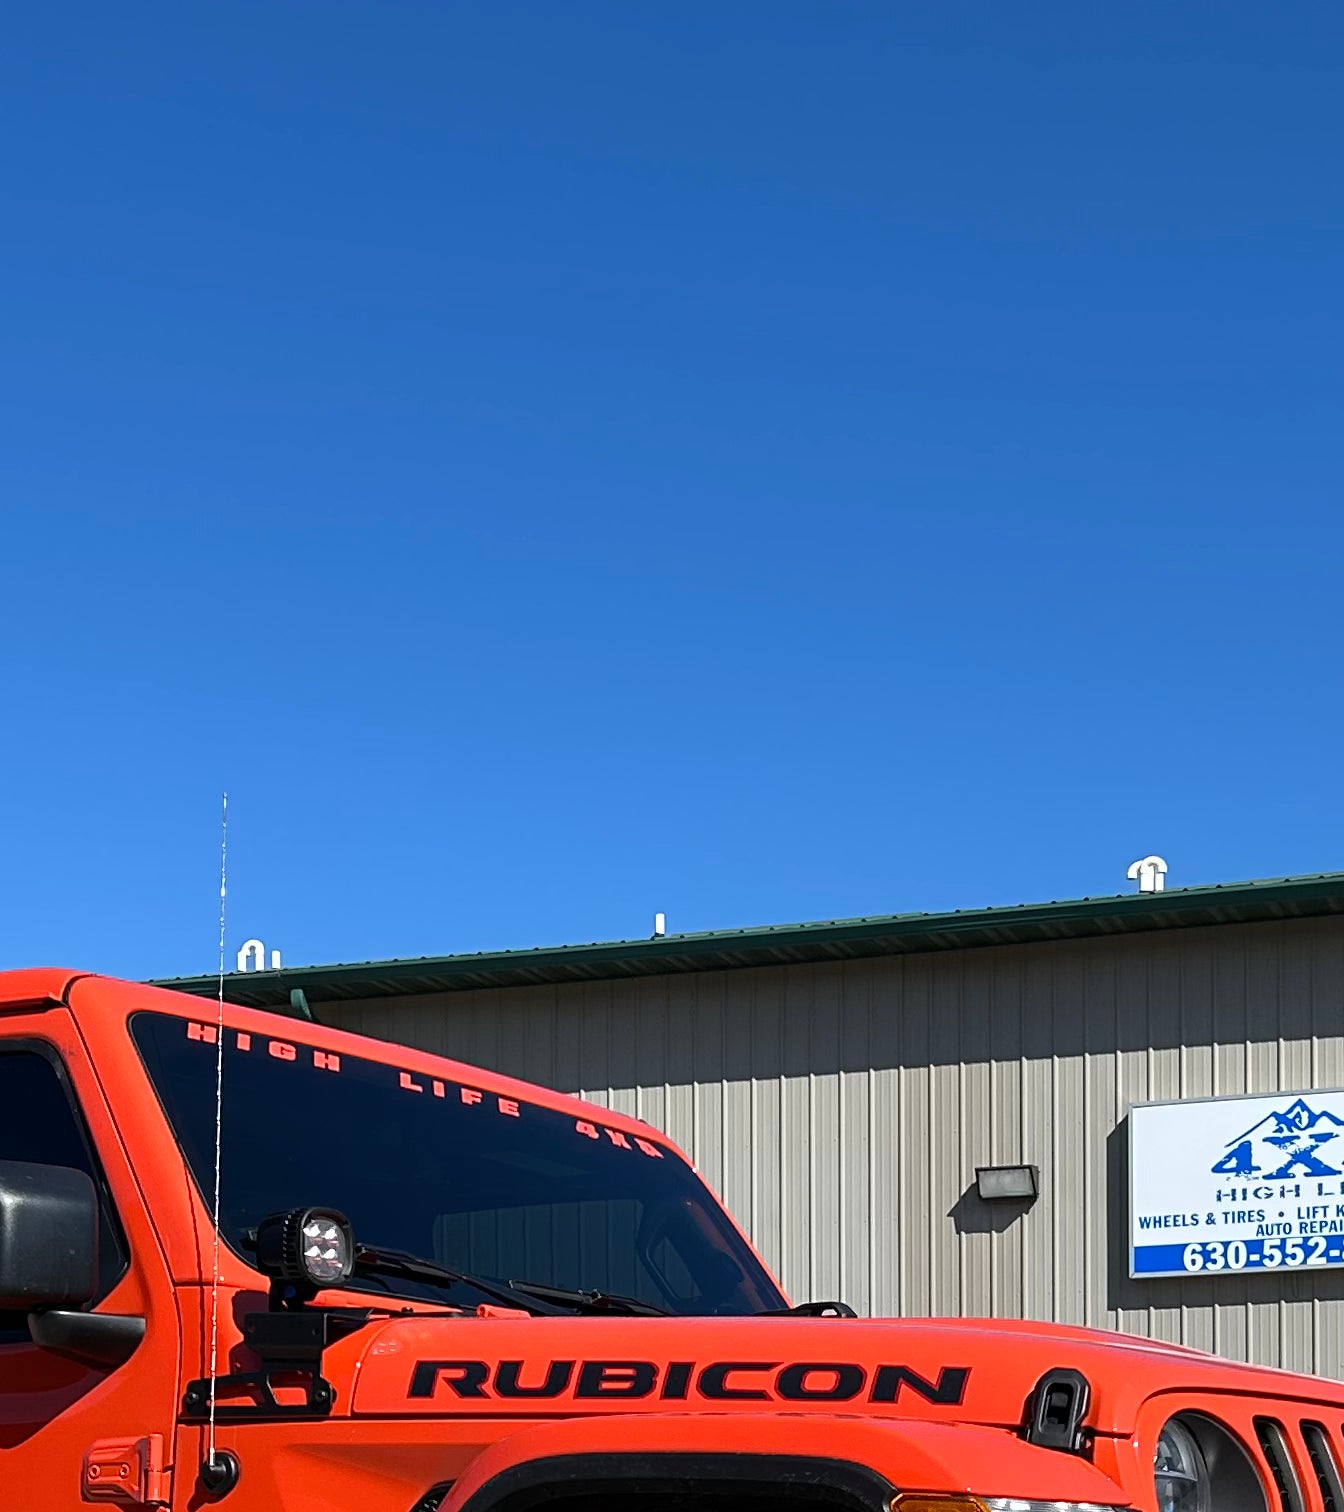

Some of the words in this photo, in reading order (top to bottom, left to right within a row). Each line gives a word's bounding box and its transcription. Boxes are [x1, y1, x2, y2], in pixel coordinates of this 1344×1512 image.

[186, 1021, 340, 1073] HIGH
[399, 1072, 520, 1118] LIFE
[1215, 1184, 1301, 1203] HIGH
[1138, 1212, 1199, 1230] WHEELS
[1204, 1212, 1217, 1226] &
[1222, 1208, 1266, 1225] TIRES
[1296, 1205, 1330, 1220] LIFT
[1255, 1221, 1296, 1237] AUTO
[406, 1359, 973, 1407] RUBICON
